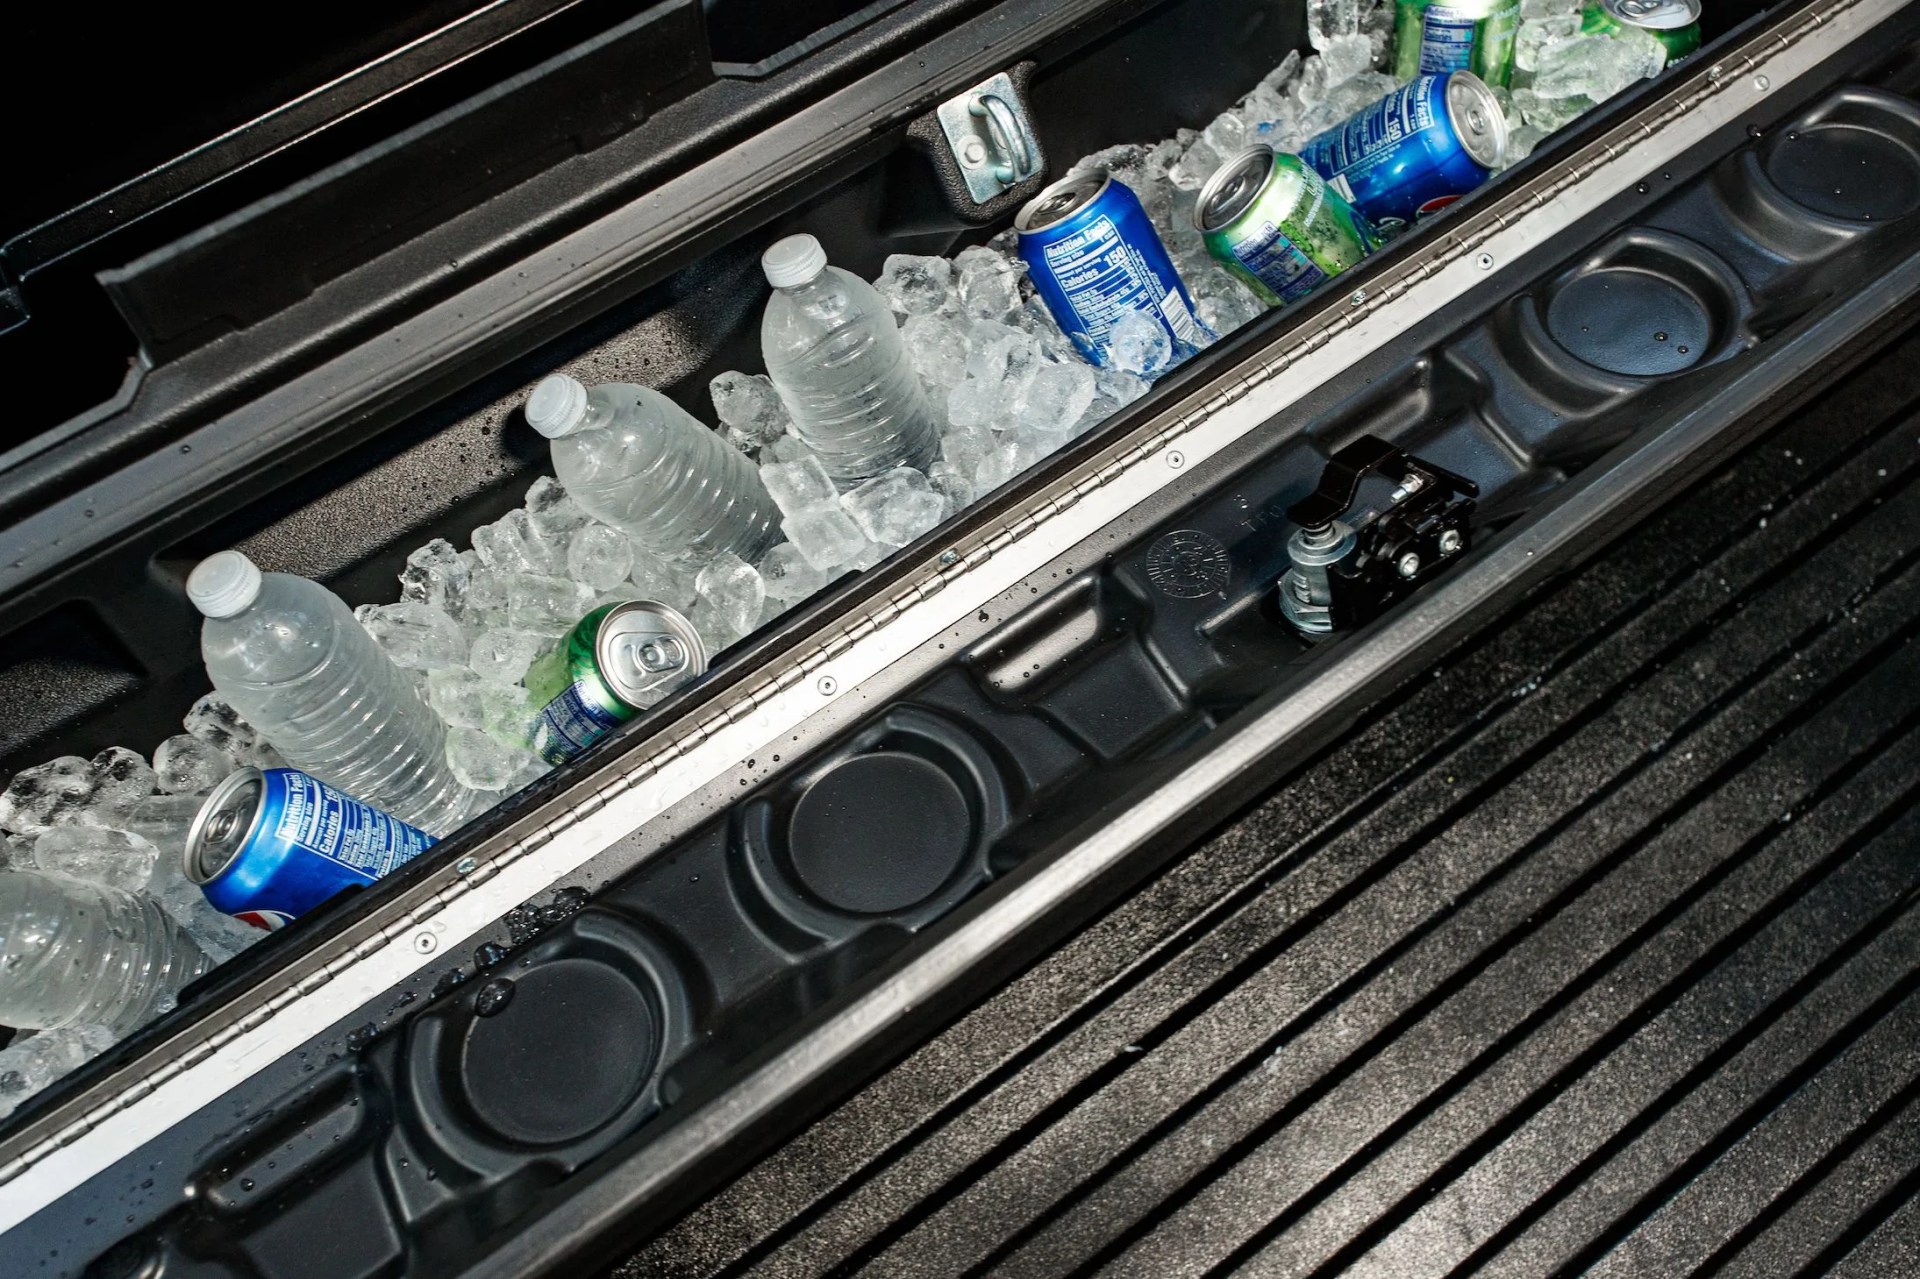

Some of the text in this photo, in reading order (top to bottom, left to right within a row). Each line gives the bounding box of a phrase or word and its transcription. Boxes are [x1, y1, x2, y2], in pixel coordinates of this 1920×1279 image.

[1388, 116, 1400, 141] 150
[1416, 98, 1429, 128] Facts
[1044, 234, 1086, 259] Nutrition
[1059, 266, 1100, 289] Calories
[1103, 246, 1126, 267] 150
[279, 774, 303, 840] Nutrition Facts
[295, 800, 314, 843] Serving size
[317, 809, 339, 854] Calories
